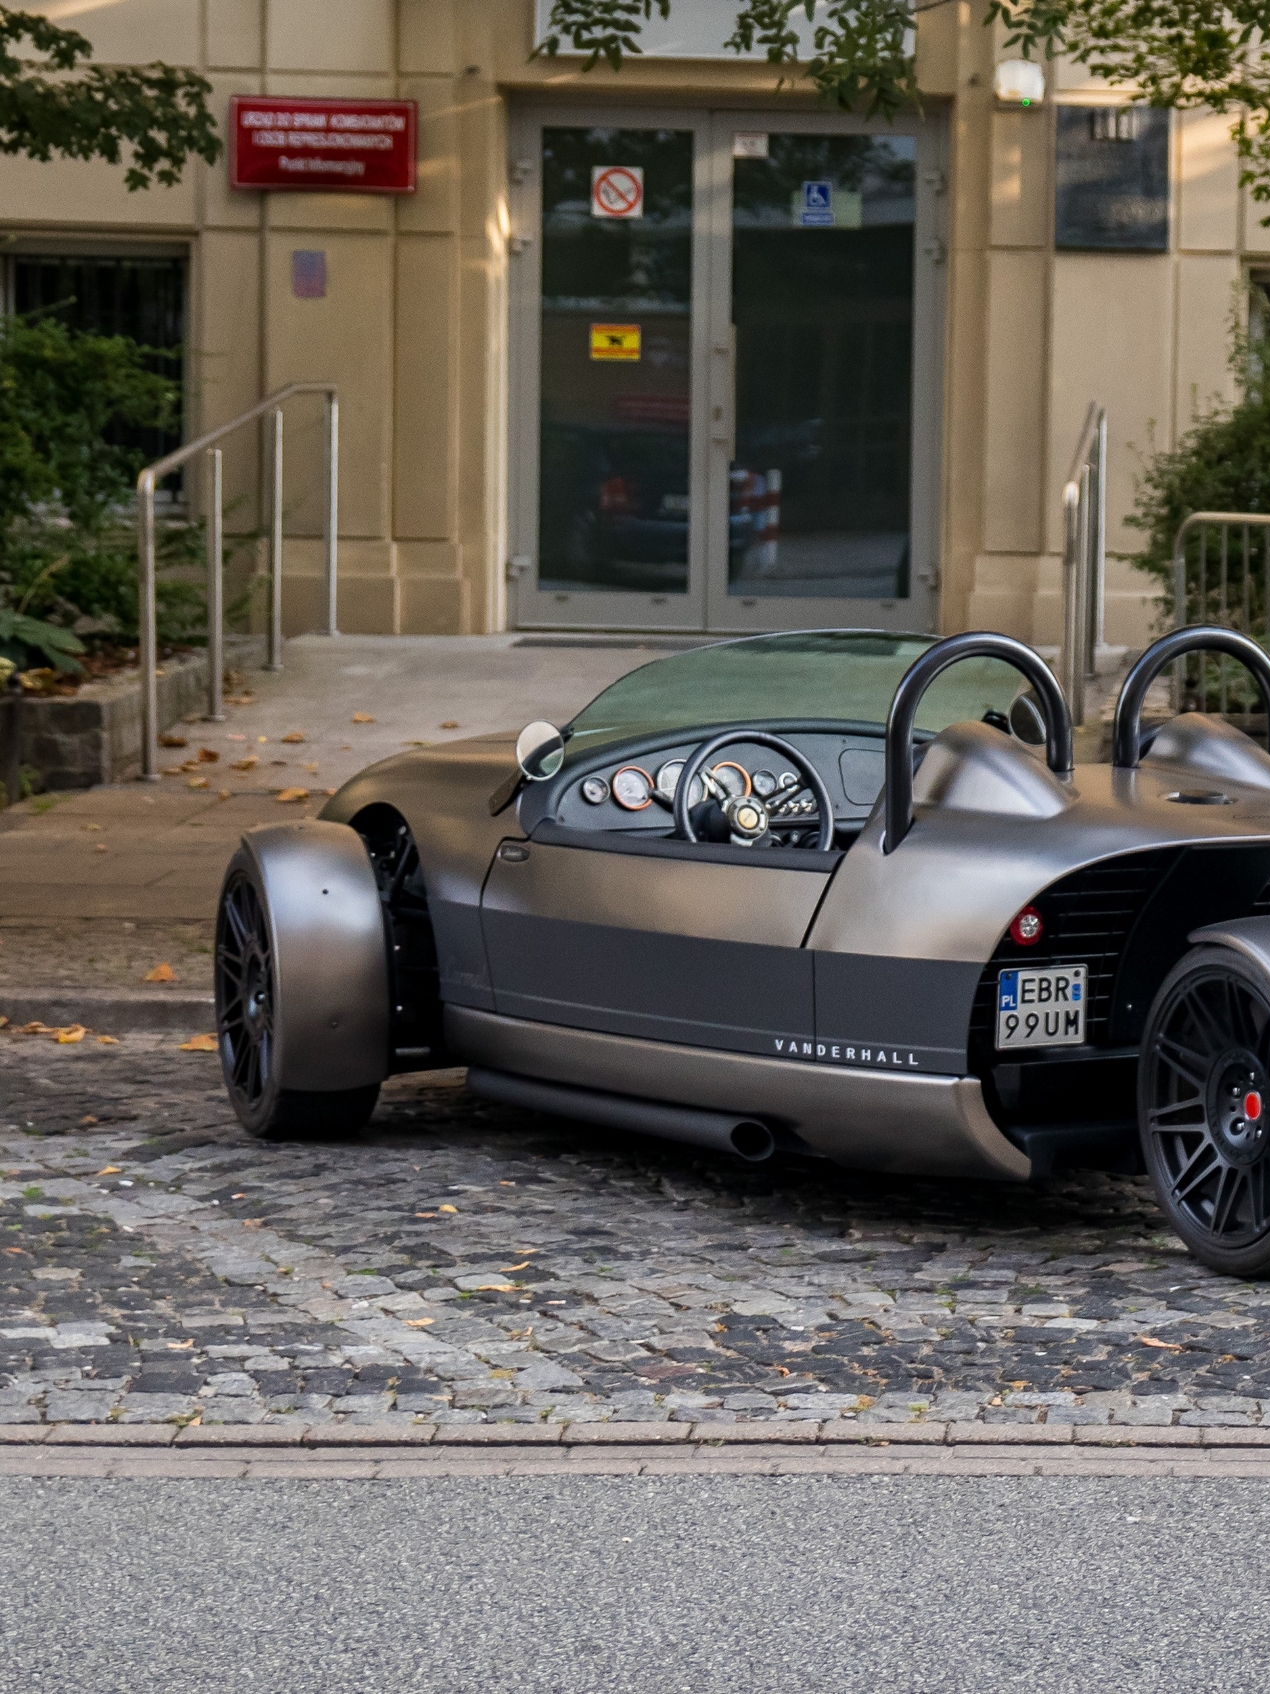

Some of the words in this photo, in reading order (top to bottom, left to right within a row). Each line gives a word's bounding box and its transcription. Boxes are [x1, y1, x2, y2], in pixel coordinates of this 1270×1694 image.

[1001, 995, 1016, 1008] PL
[1020, 976, 1070, 1004] EBR
[1005, 1010, 1080, 1040] 99UM
[774, 1039, 919, 1066] VANDERHALL
